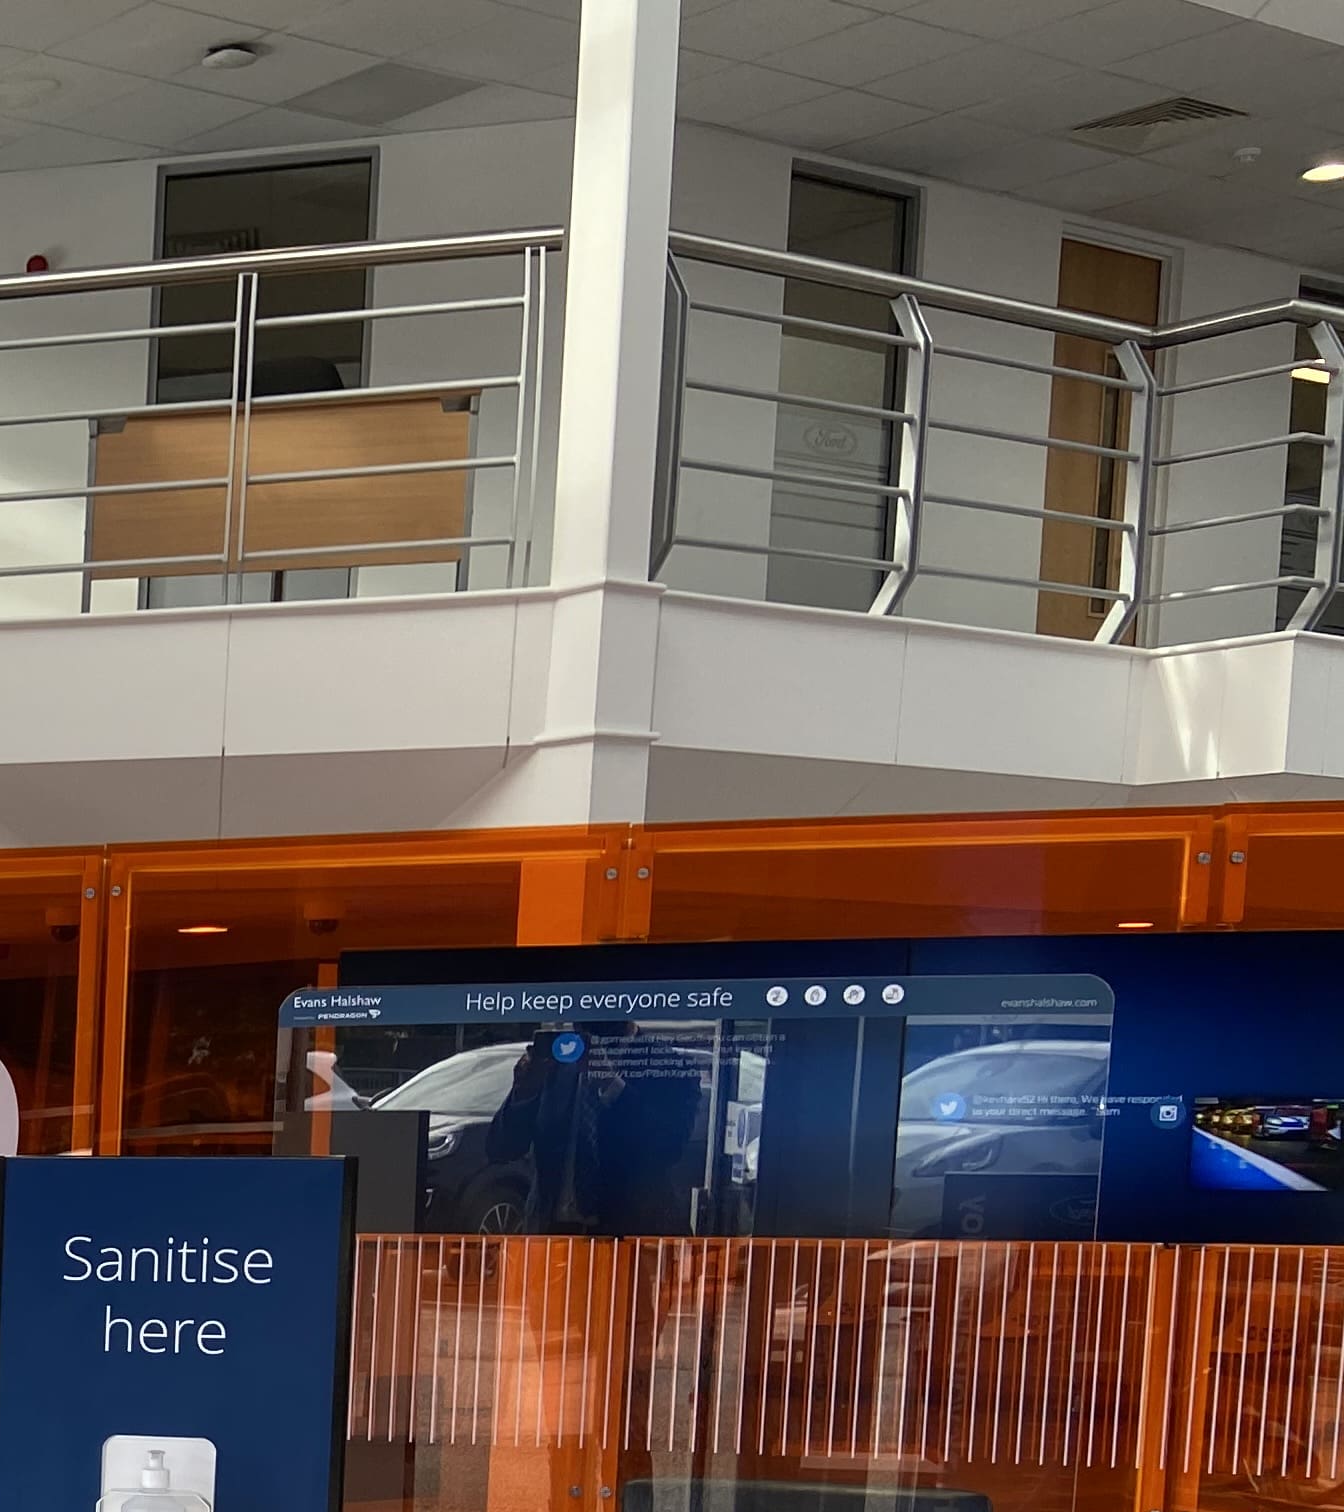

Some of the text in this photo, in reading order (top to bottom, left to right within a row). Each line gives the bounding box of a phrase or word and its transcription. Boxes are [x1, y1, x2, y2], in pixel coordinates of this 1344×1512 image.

[294, 995, 381, 1008] Evans Halshaw
[466, 987, 733, 1015] Help keep everyone safe
[1001, 998, 1098, 1008] evanshalshaw.com
[318, 1012, 368, 1020] PENDRAGON
[63, 1235, 273, 1285] Sanitise
[104, 1305, 226, 1355] here
